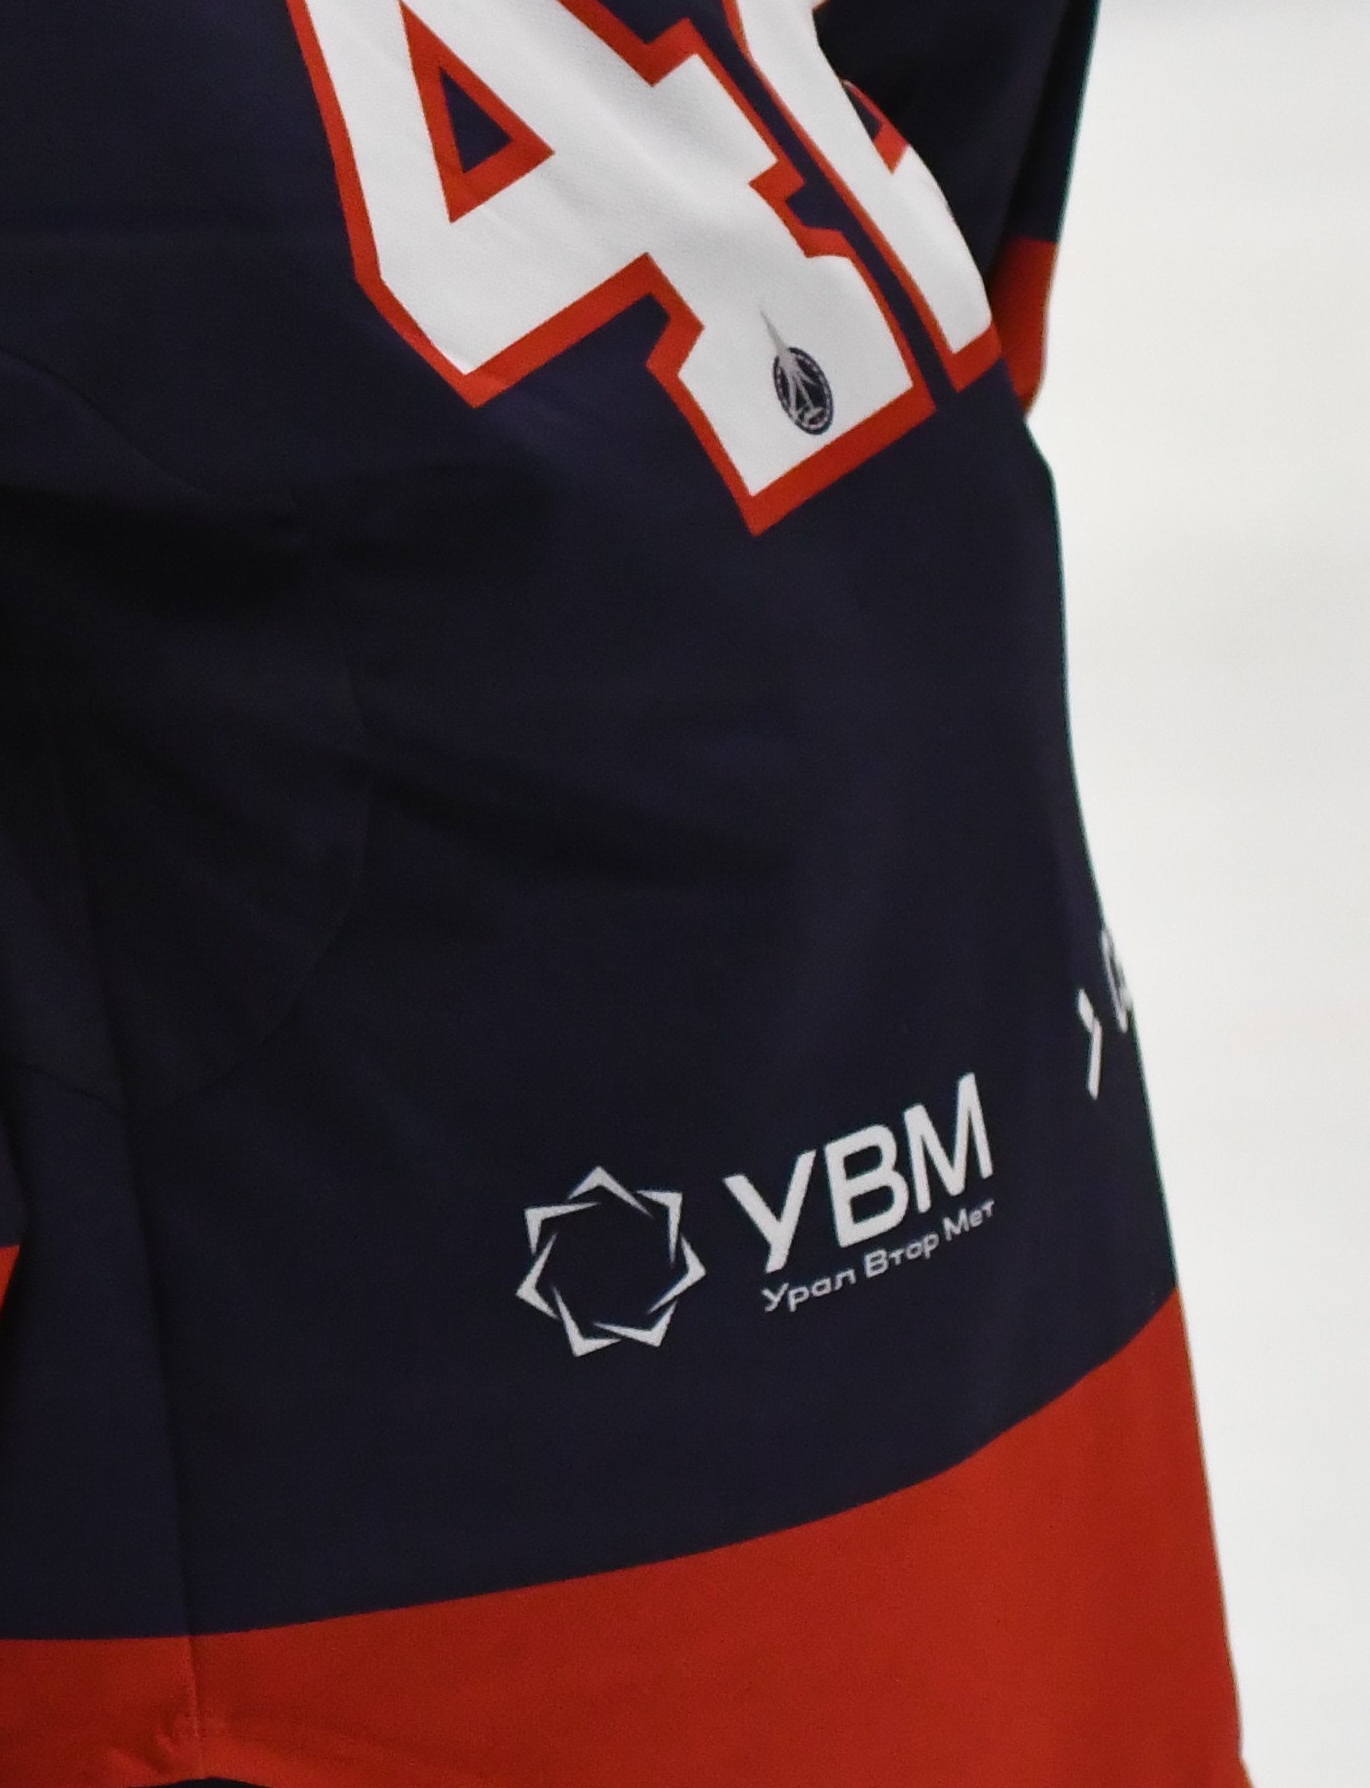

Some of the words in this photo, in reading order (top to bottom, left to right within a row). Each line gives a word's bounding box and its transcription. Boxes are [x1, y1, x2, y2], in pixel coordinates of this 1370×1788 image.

[761, 1267, 857, 1312] Урал
[863, 1231, 940, 1279] Втор
[942, 1198, 996, 1242] Мет
